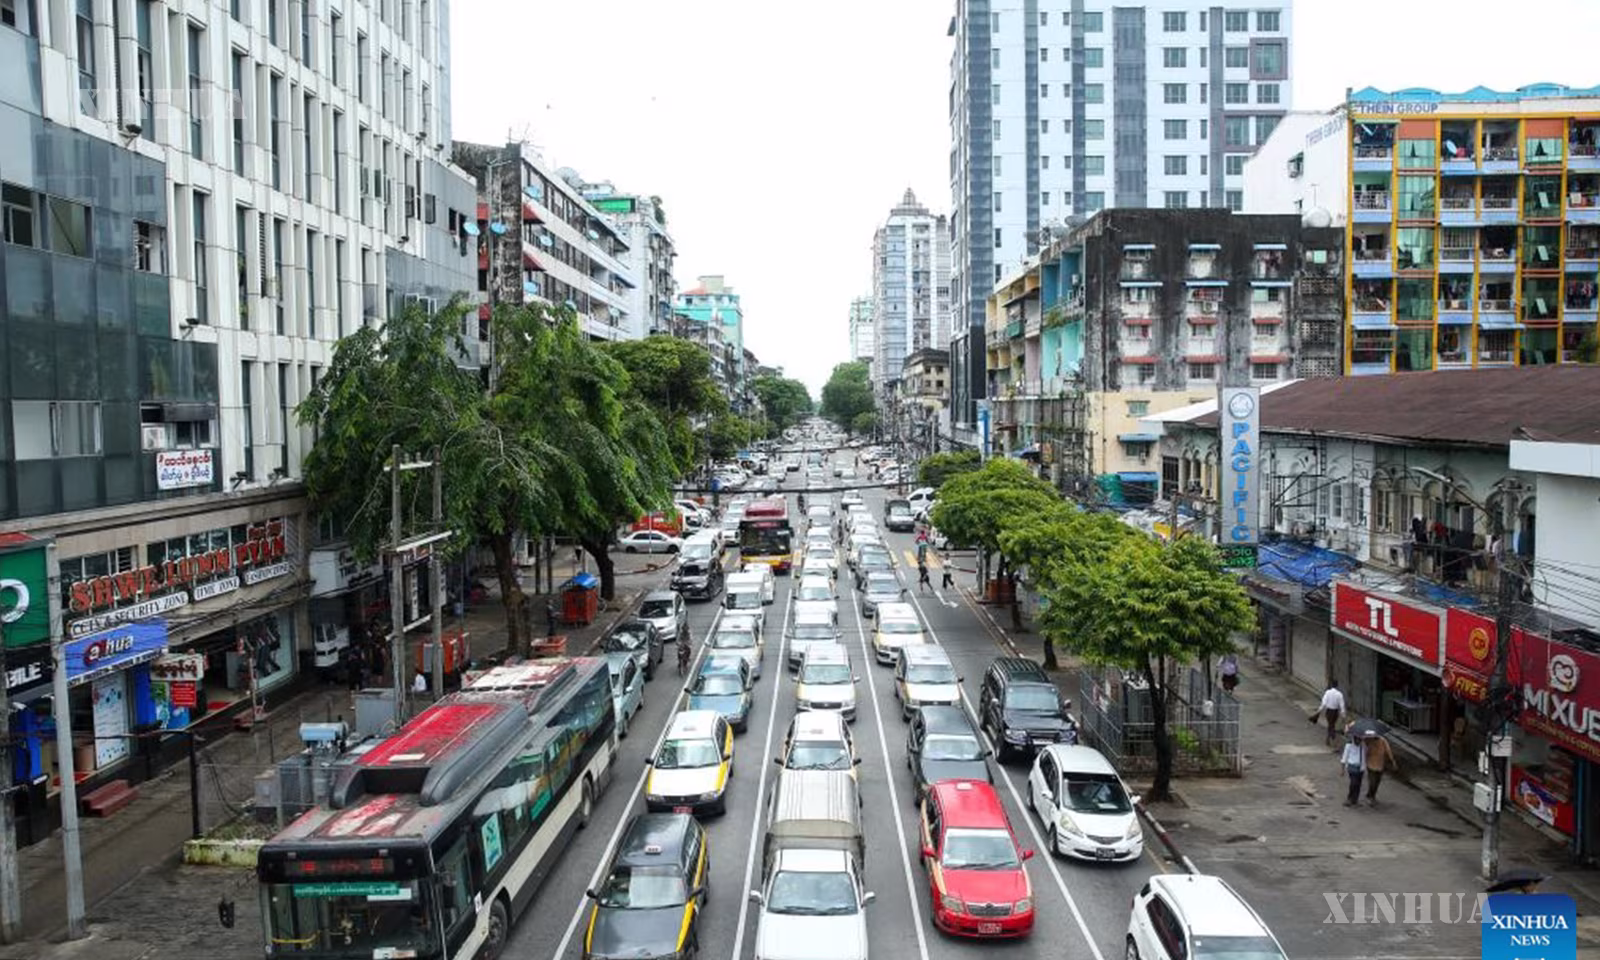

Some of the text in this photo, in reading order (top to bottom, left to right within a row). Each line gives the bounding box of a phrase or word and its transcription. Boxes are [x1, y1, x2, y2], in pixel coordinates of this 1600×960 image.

[1359, 102, 1439, 113] THEIN GROUP
[1231, 422, 1252, 541] PACIFIC
[68, 564, 163, 614] SHWE
[163, 594, 186, 610] ZONE
[1365, 596, 1399, 638] TL
[5, 662, 42, 688] BILE
[1456, 676, 1481, 696] FIVE
[1523, 683, 1600, 742] MIXUE
